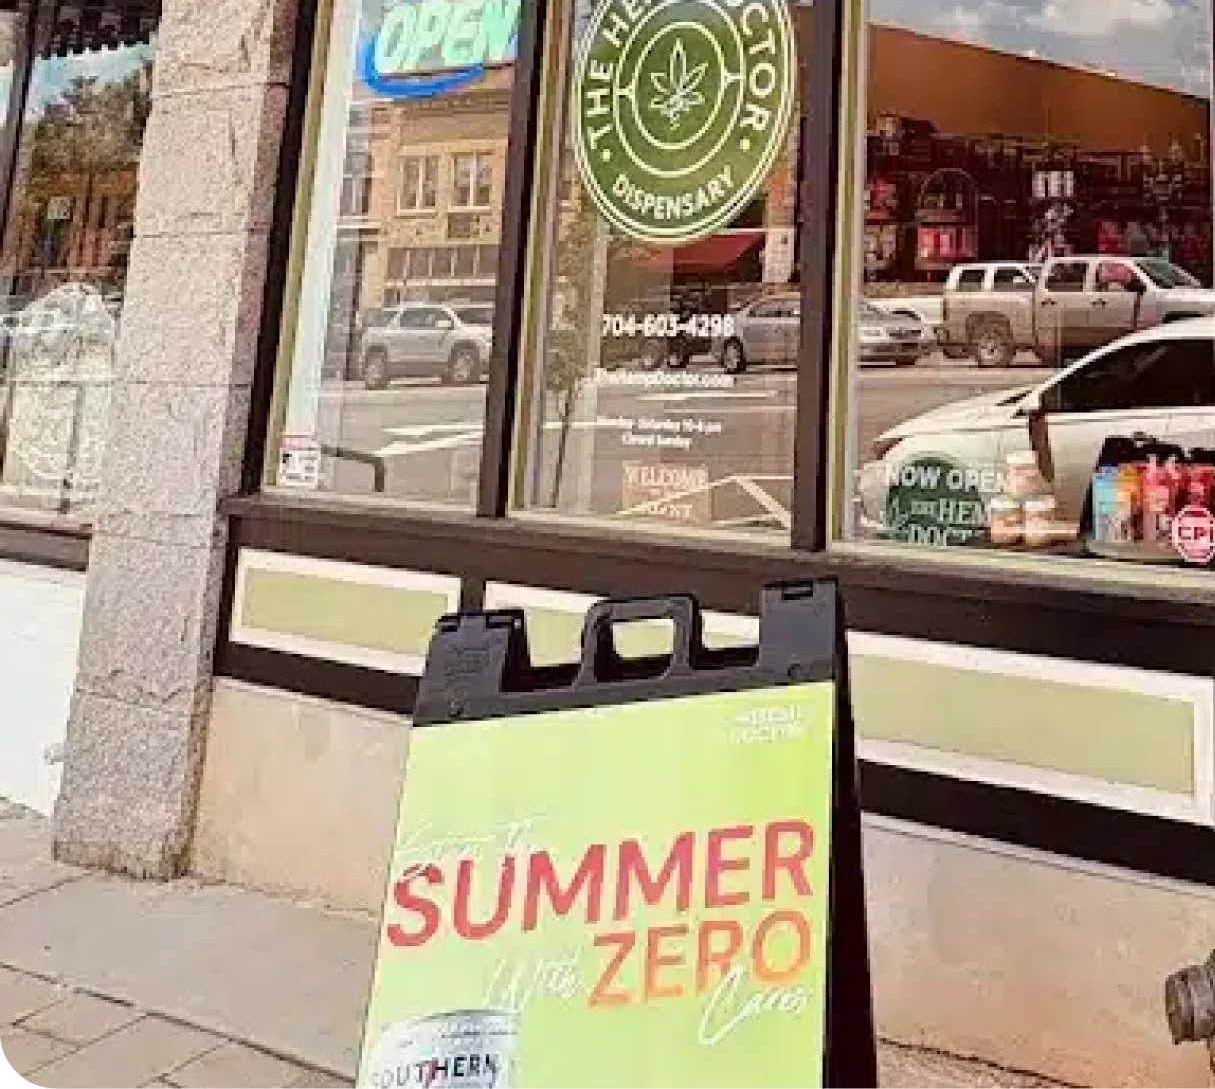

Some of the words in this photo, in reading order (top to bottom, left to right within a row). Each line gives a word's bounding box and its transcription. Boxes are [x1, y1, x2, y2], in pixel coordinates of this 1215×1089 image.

[586, 59, 614, 150] THE
[612, 166, 734, 220] DISPENSARY
[884, 462, 941, 490] NOW
[386, 818, 815, 948] SUMMER
[586, 910, 811, 1011] ZERO
